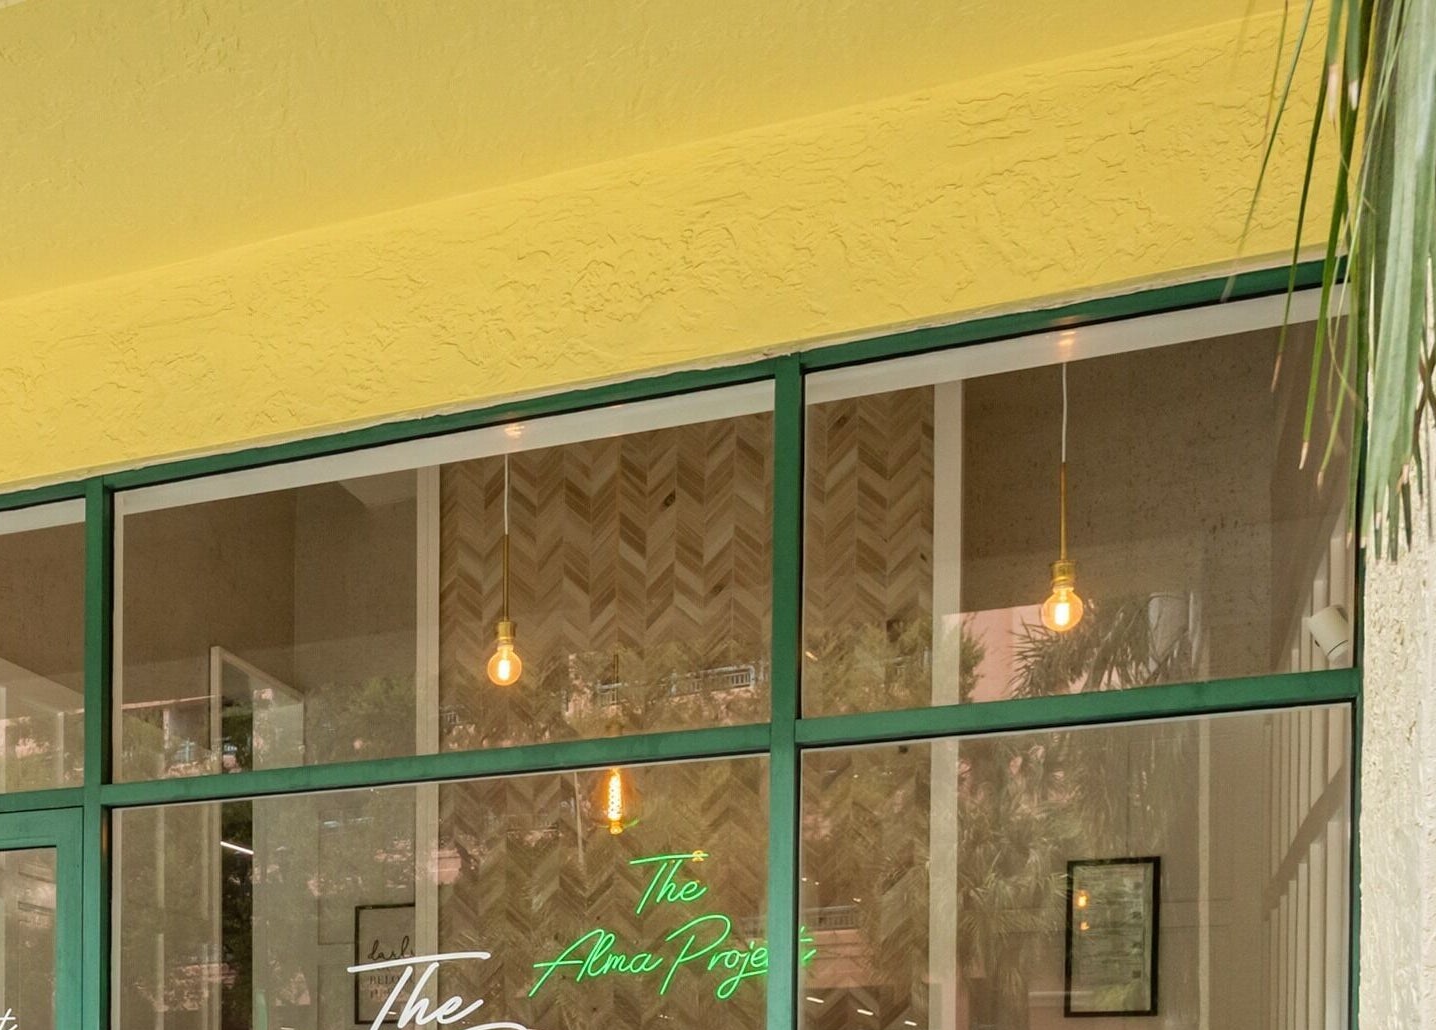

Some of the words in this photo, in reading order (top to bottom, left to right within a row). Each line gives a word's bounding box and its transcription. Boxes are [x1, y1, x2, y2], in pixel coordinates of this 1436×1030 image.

[629, 853, 709, 915] The
[528, 928, 663, 997] Alma
[659, 914, 817, 999] Proje
